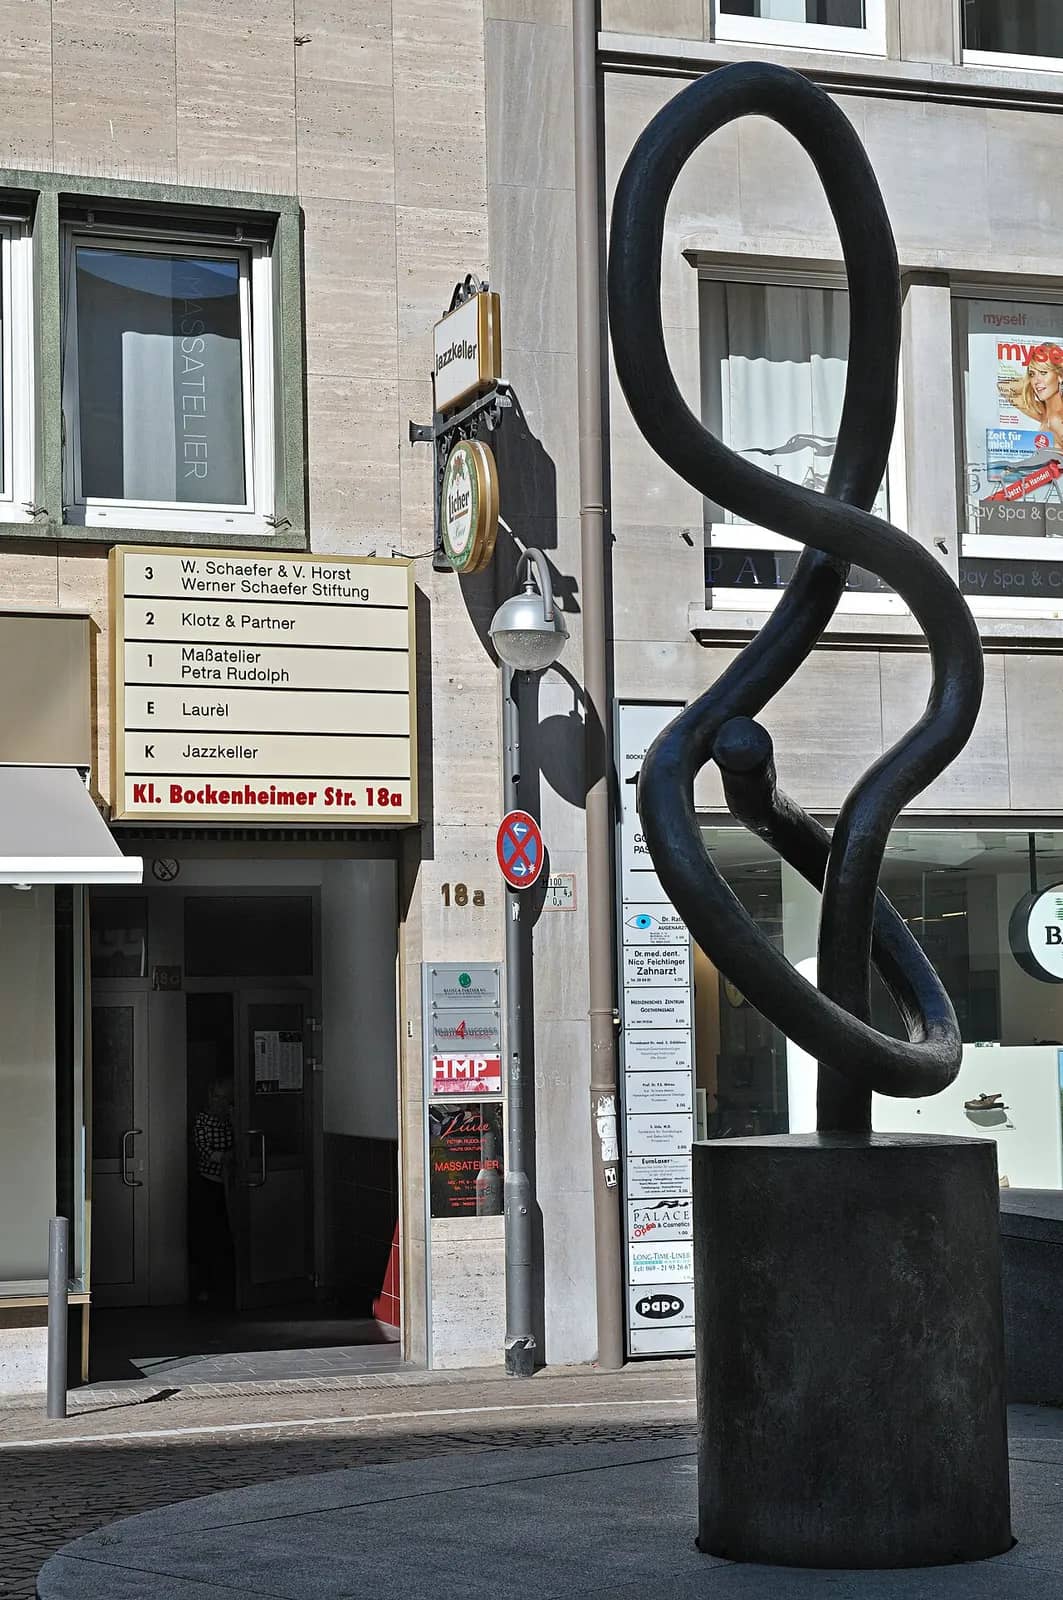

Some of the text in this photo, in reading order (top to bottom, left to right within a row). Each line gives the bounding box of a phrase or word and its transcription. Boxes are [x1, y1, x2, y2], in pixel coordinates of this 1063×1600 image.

[984, 312, 1026, 326] myself
[1008, 432, 1022, 440] für
[998, 505, 1026, 521] Spa
[1031, 507, 1042, 520] &
[144, 567, 154, 580] 3
[181, 560, 352, 580] W. Schaefer & V. Horst
[992, 569, 1025, 588] Spa
[1032, 570, 1042, 586] &
[181, 578, 370, 600] Werner Schaefer Stiftung
[146, 612, 296, 630] 2 Klotz & Partner
[147, 654, 153, 668] 1
[181, 648, 261, 664] Maßatelier
[181, 666, 290, 684] Petra Rudolph
[147, 702, 229, 717] E Laurèl
[145, 744, 258, 760] K Jazzkeller
[133, 784, 402, 807] Kl. Bockenheimer Str. 18a
[634, 846, 650, 854] PAS
[550, 878, 562, 886] 100
[441, 882, 486, 907] 18a
[1044, 926, 1063, 945] B
[636, 967, 677, 975] Zahnarzt
[432, 1059, 488, 1079] HMP
[434, 1160, 499, 1172] MASSATELIER
[634, 1210, 690, 1222] PALACE
[641, 1300, 680, 1314] papo
